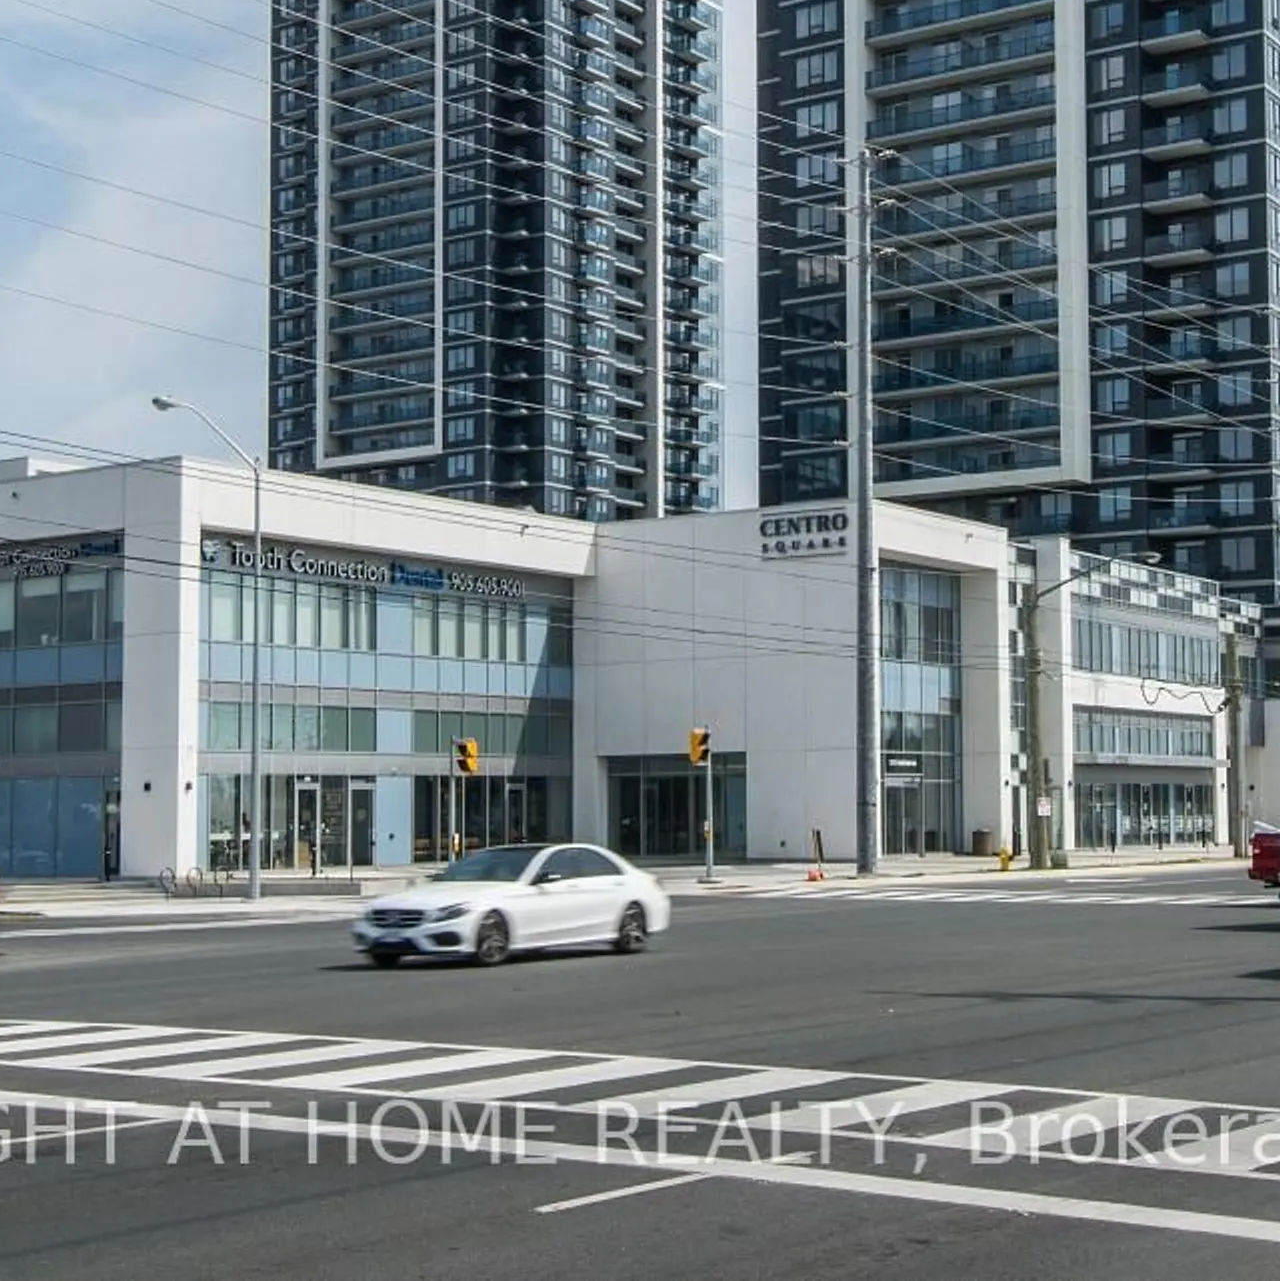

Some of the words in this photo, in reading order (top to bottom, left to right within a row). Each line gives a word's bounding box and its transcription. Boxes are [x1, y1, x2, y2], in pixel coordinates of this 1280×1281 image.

[760, 513, 849, 537] CENTRO
[761, 536, 847, 554] SQUARE
[231, 541, 283, 569] Tooth
[291, 549, 388, 582] Connection
